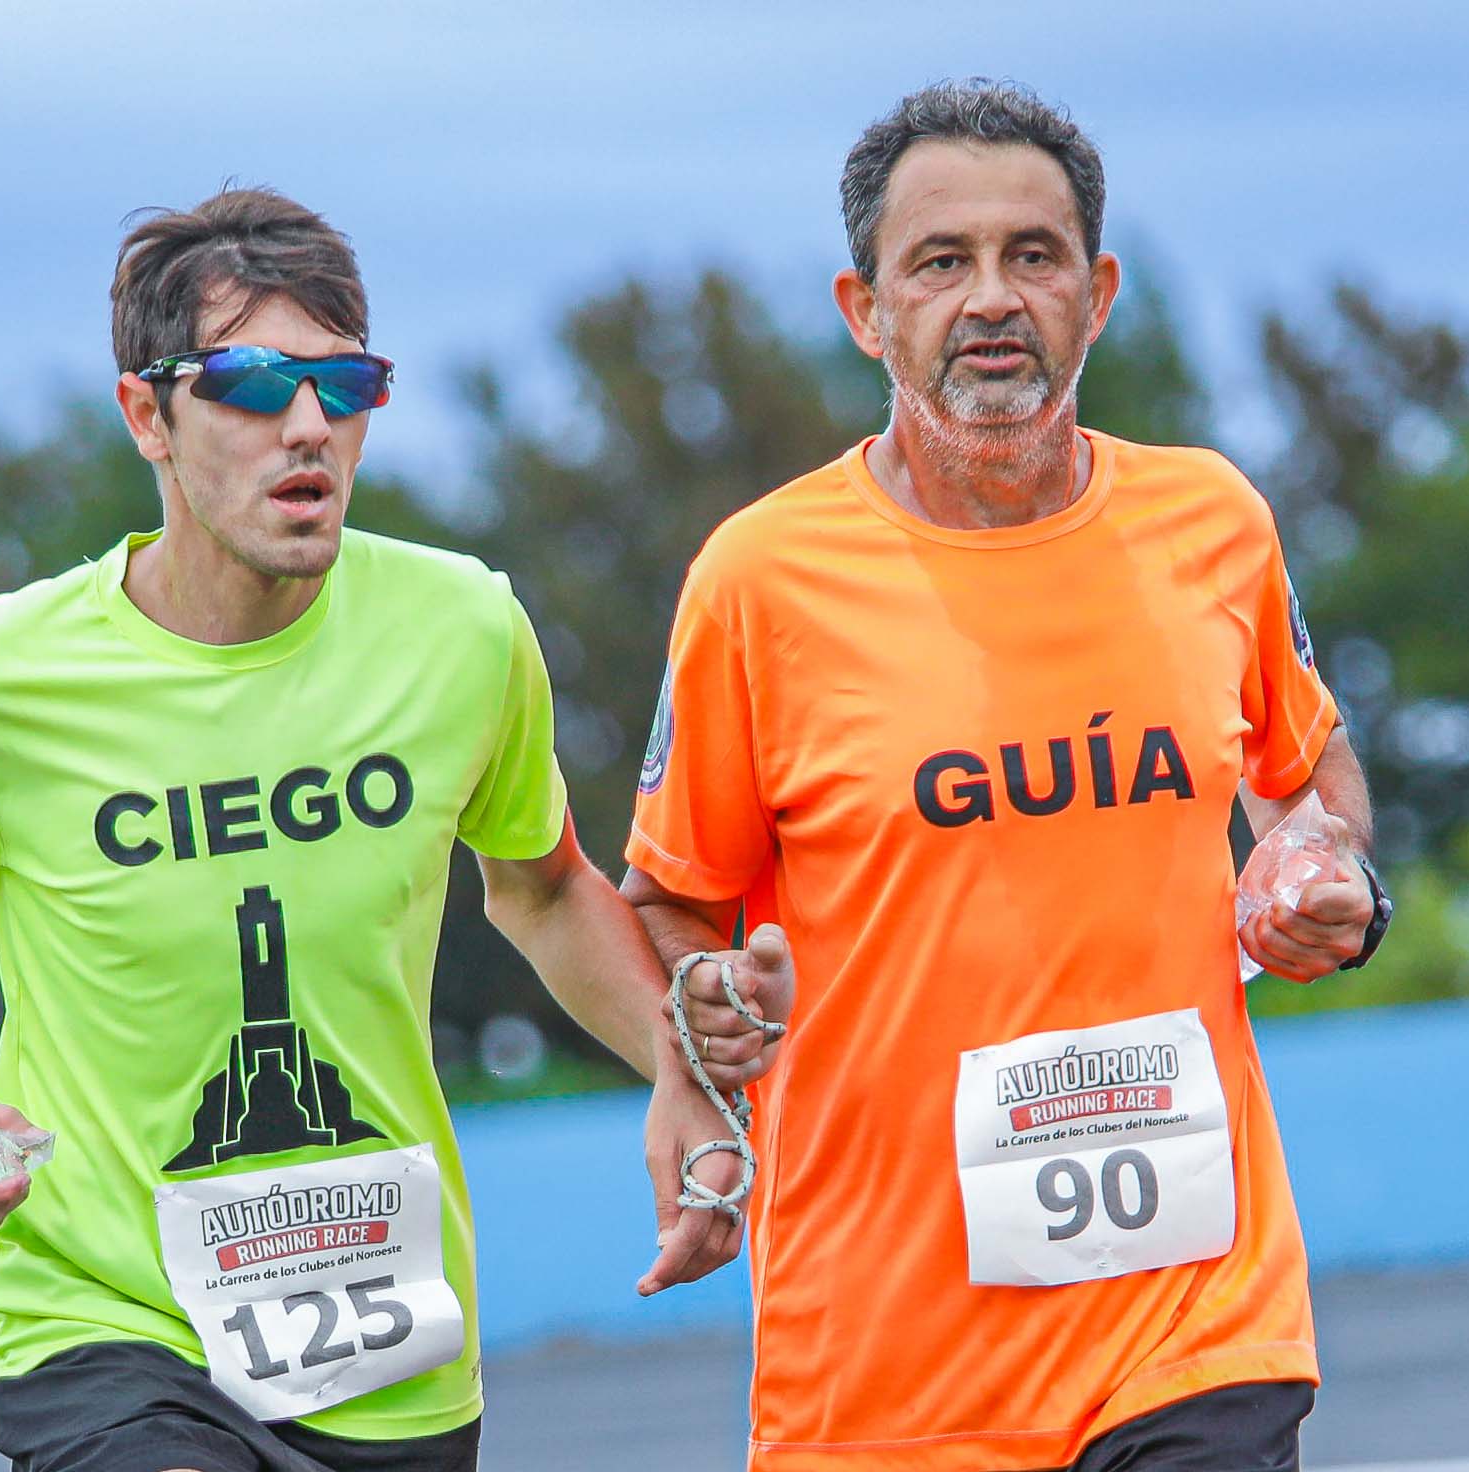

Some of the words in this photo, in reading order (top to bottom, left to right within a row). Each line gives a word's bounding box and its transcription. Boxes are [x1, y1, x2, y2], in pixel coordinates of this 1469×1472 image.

[914, 710, 1196, 829] GUÍA
[94, 752, 415, 867] CIEGO
[996, 1044, 1180, 1106] AUTÓDROMO
[995, 1137, 1008, 1149] La
[1010, 1133, 1050, 1146] Carrera
[1052, 1129, 1067, 1140] de
[1069, 1126, 1084, 1138] los
[1086, 1120, 1123, 1135] Clubes
[1125, 1118, 1142, 1130] del
[1144, 1113, 1190, 1128] Noroeste
[1029, 1092, 1108, 1125] RUNNING
[1112, 1089, 1157, 1110] RACE
[201, 1182, 402, 1247] AUTÓDROMO
[1036, 1148, 1159, 1241] 90
[205, 1279, 218, 1290] La
[219, 1272, 261, 1287] Carrera
[263, 1268, 278, 1280] de
[280, 1265, 297, 1277] los
[298, 1258, 336, 1274] Clubes
[337, 1252, 354, 1266] del
[356, 1244, 403, 1262] Noroeste
[235, 1231, 318, 1265] RUNNING
[323, 1225, 369, 1247] RACE
[222, 1274, 414, 1381] 125
